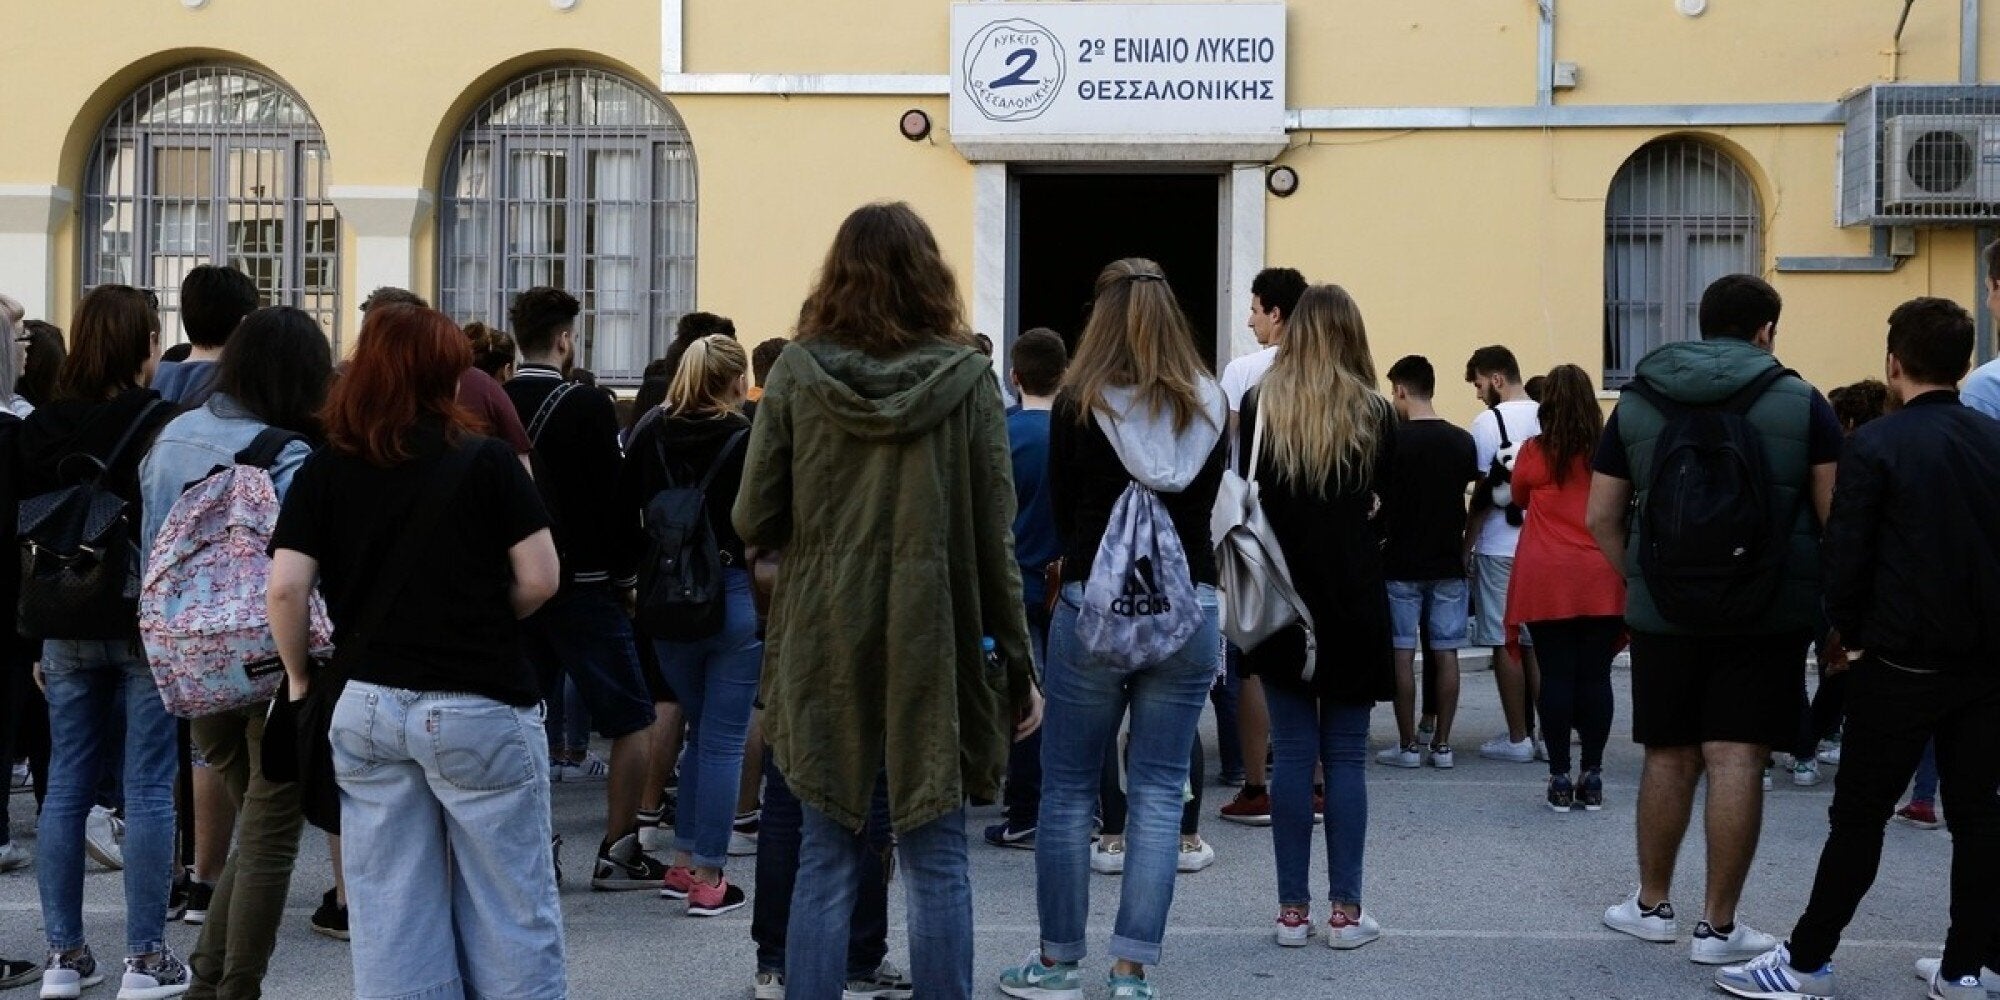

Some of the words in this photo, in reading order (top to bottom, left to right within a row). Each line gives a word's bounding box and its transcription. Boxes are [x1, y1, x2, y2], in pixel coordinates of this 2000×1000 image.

[1114, 37, 1189, 64] ΕΝΙΑΙΟ
[1195, 37, 1274, 63] ΛΥΚΕΙΟ
[988, 47, 1038, 89] 2
[1077, 79, 1274, 101] ΘΕΣΣΑΛΟΝΙΚΗΣ
[1111, 592, 1171, 617] addas
